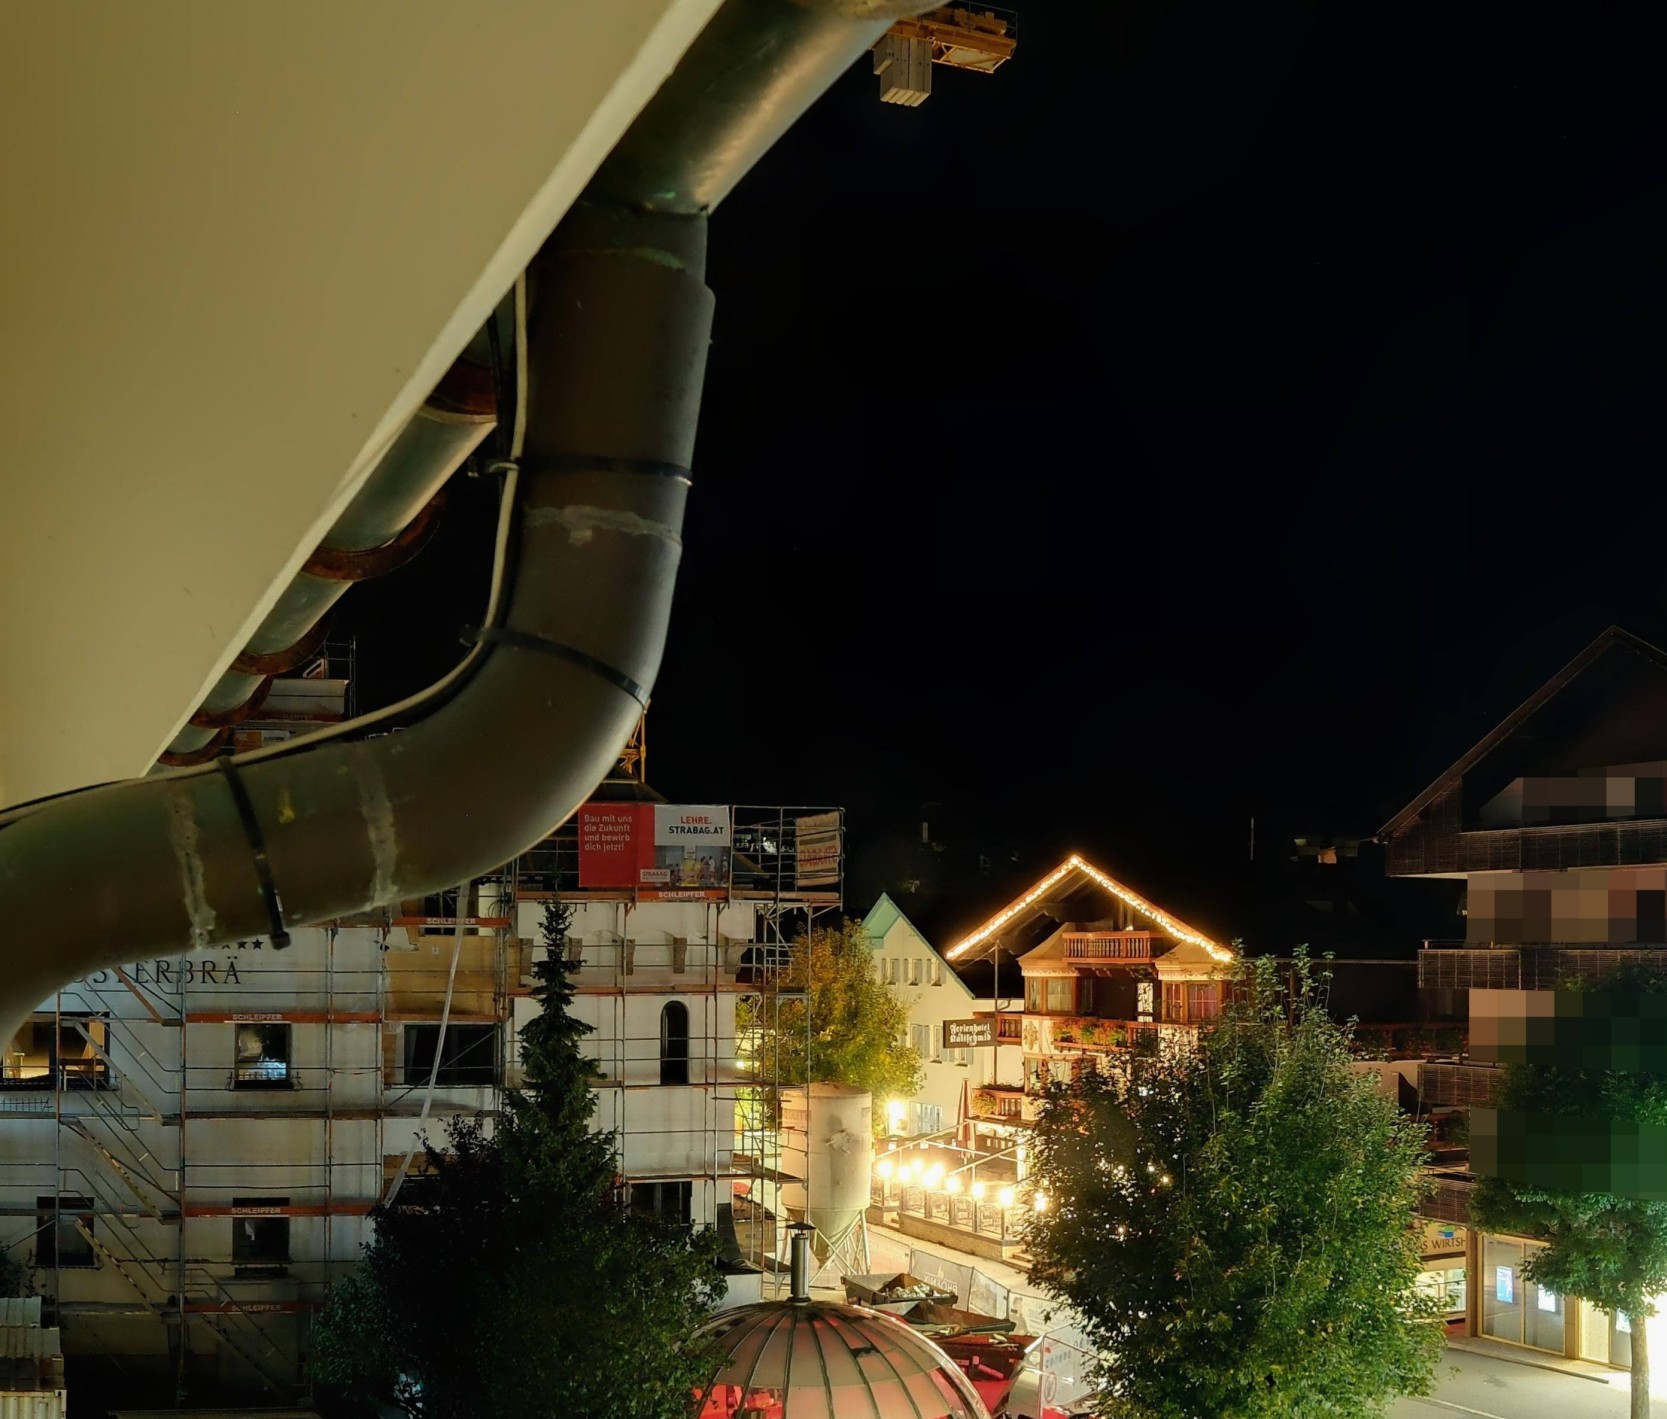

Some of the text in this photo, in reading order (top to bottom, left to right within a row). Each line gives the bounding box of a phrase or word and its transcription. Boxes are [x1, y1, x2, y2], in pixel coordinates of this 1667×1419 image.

[584, 814, 601, 823] Bau
[603, 814, 616, 823] mit
[680, 815, 713, 825] LEHRE.
[584, 823, 631, 833] die Zukunft
[668, 825, 724, 835] STRABAG.AT
[584, 833, 631, 842] und bewirb
[584, 842, 625, 853] dich jetzt!
[232, 1013, 283, 1021] SCHLEIPFER
[231, 1207, 281, 1215] SCHLEIPFER
